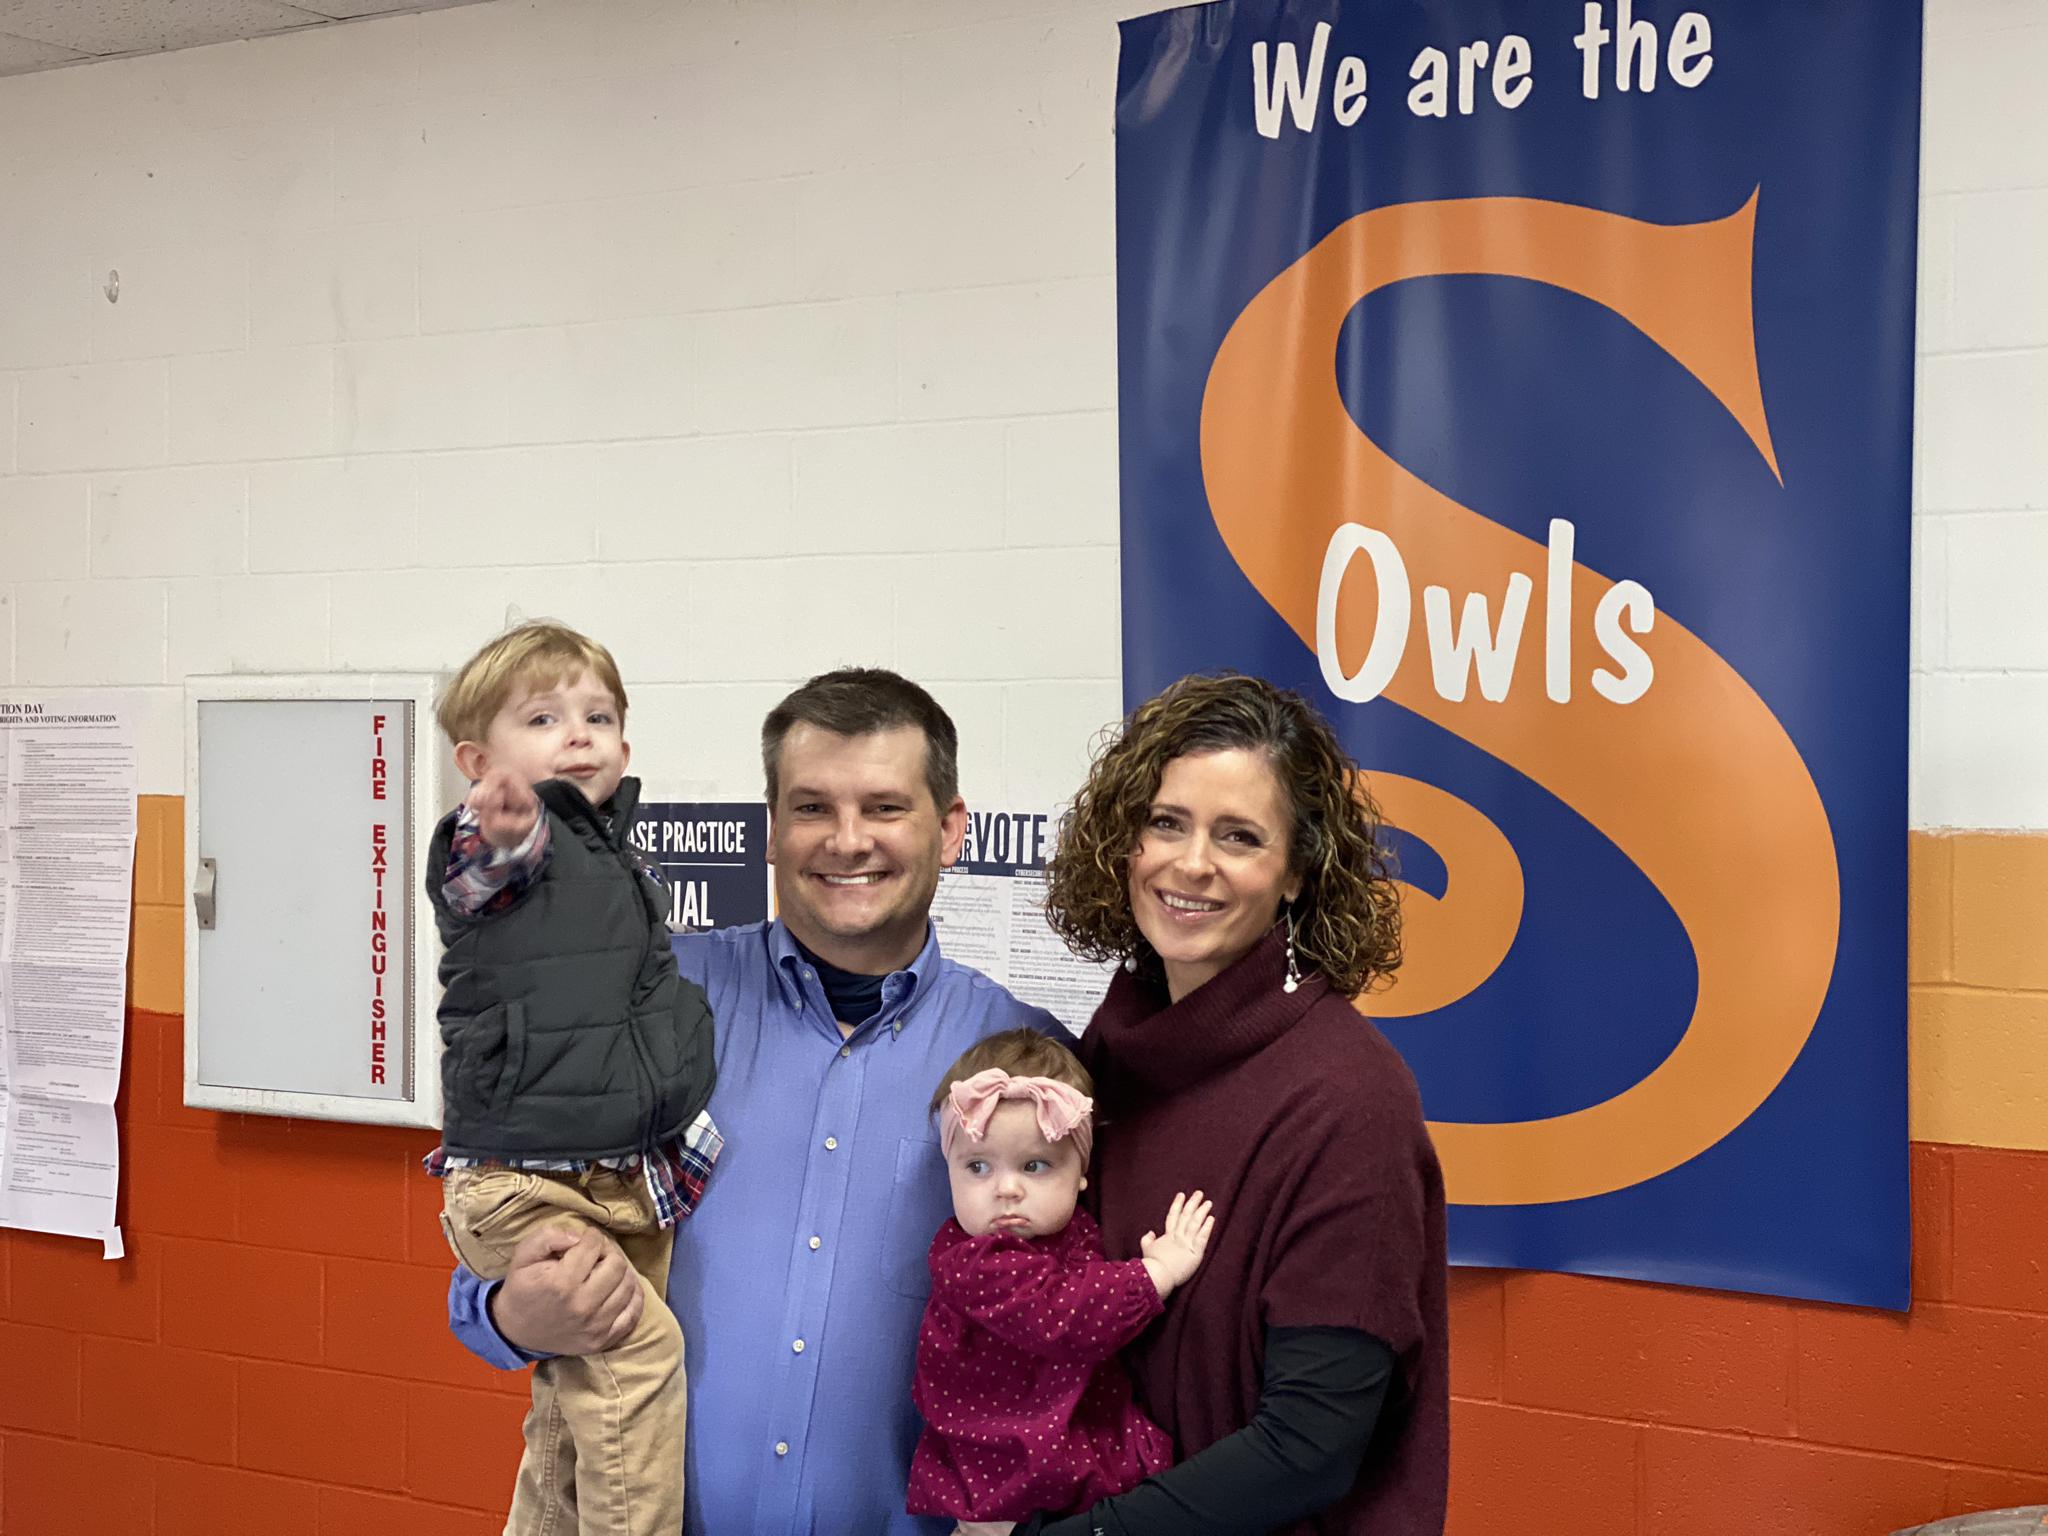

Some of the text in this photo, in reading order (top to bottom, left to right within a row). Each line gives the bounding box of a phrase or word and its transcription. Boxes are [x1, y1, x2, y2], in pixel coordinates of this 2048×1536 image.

[1253, 0, 1713, 138] We are the
[1316, 519, 1655, 704] Owls
[25, 704, 44, 714] DAY
[40, 715, 66, 723] VOTING
[68, 714, 117, 723] INFORMATION
[663, 821, 746, 853] PRACTICE
[974, 812, 1048, 864] VOTE
[371, 716, 387, 1084] FIRE EXTINGUISHER
[665, 881, 715, 927] IAL
